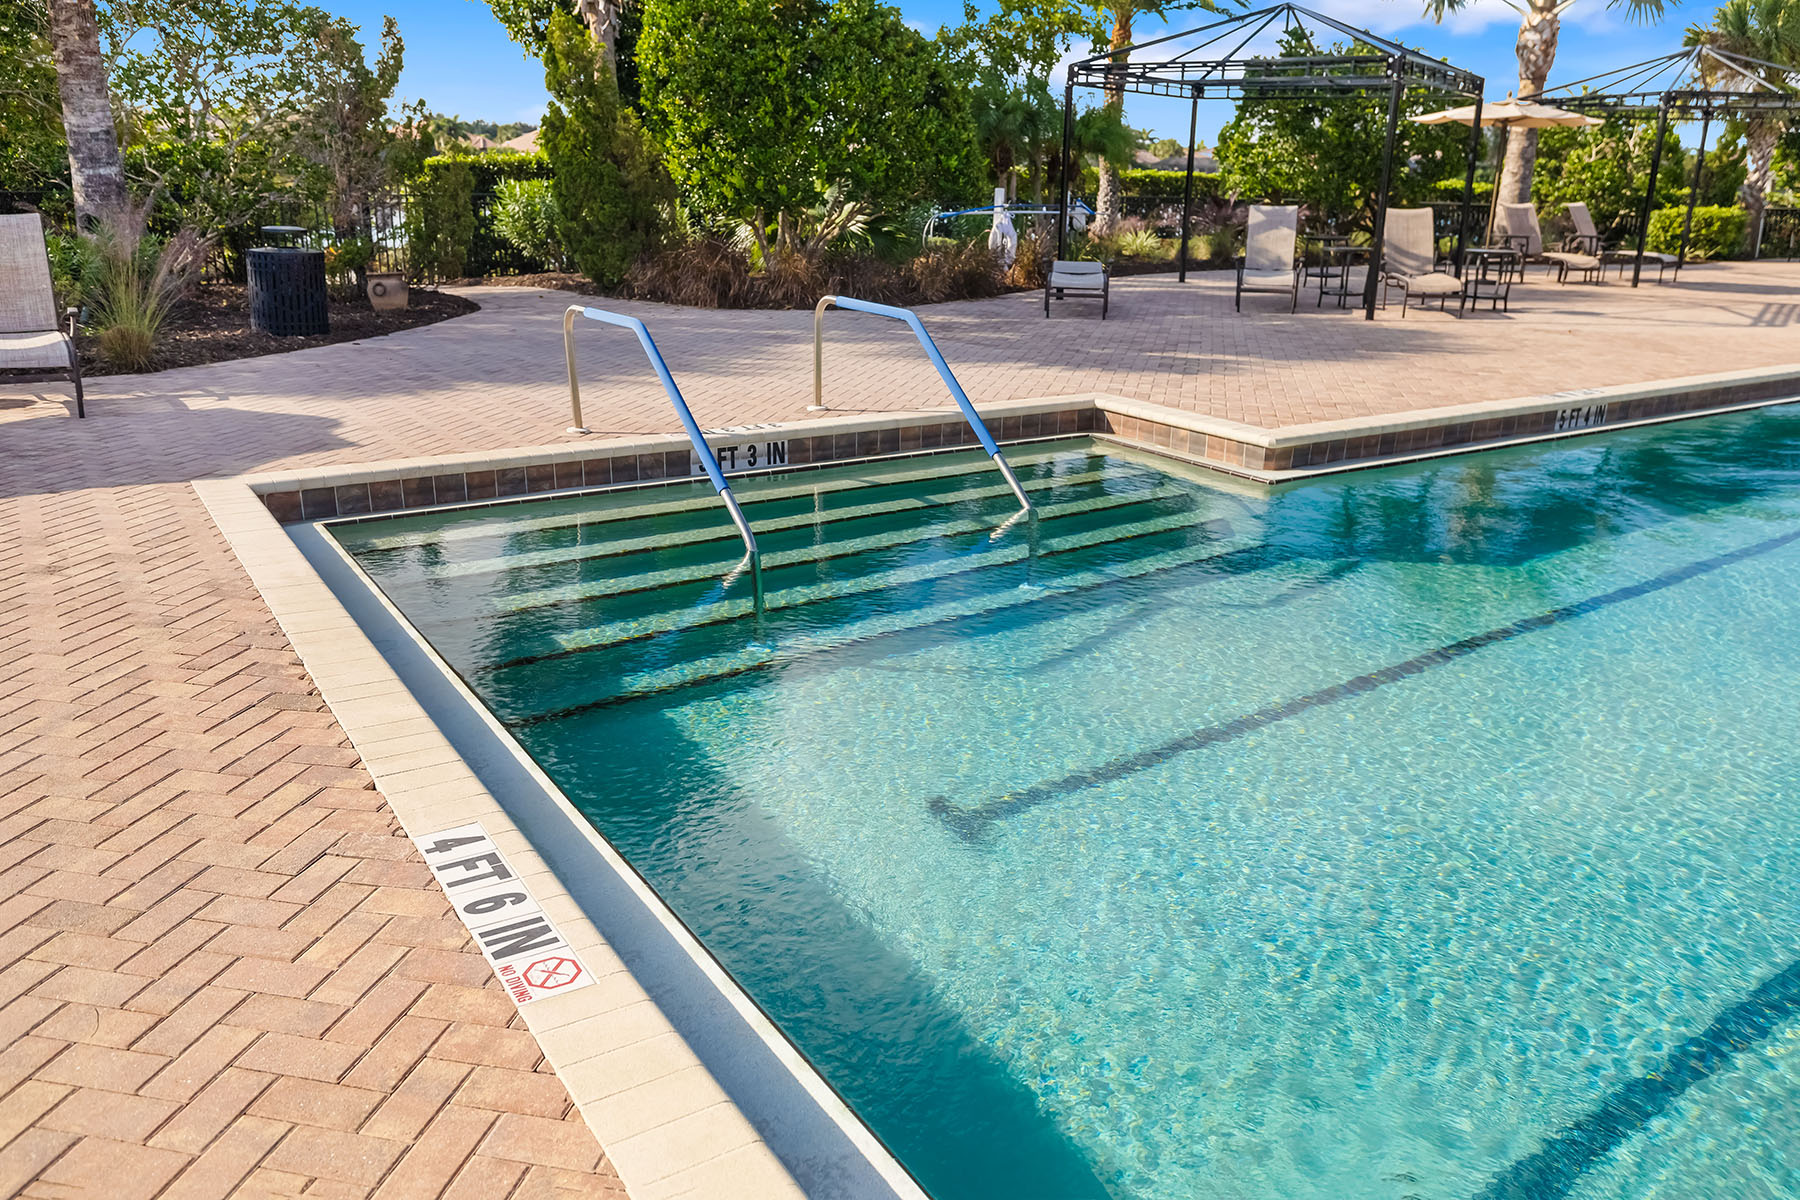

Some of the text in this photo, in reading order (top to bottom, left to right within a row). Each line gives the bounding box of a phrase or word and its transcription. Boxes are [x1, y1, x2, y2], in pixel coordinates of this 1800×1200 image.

[1558, 404, 1607, 430] 5 FT 4 IN
[717, 446, 739, 470] FT
[747, 444, 758, 467] 3
[766, 440, 786, 465] IN
[424, 835, 560, 960] 4 FT 6 IN
[498, 964, 533, 1003] NO DIVING
